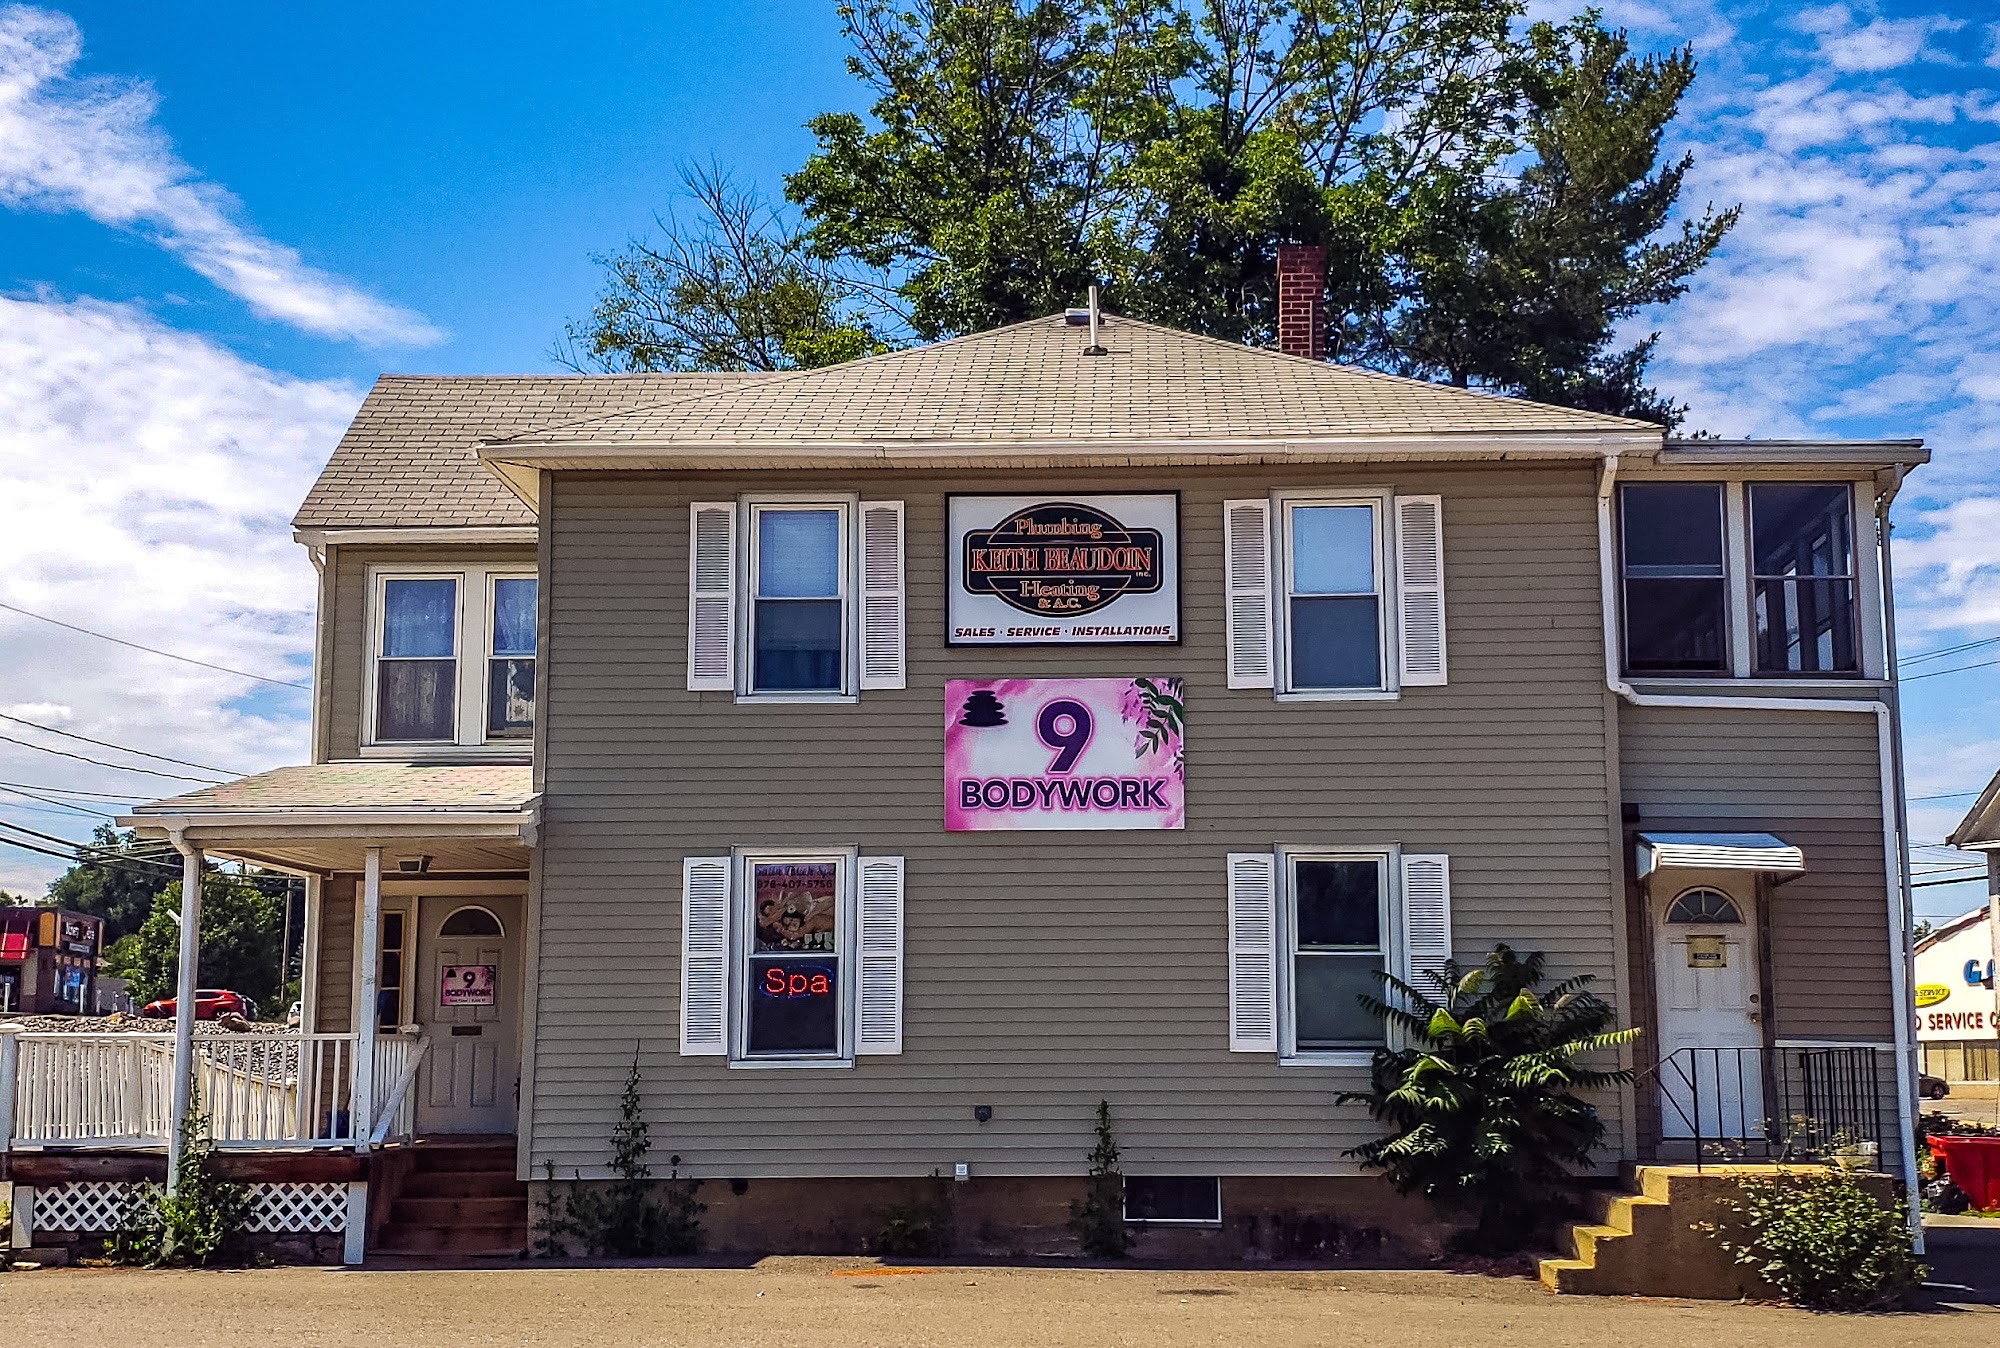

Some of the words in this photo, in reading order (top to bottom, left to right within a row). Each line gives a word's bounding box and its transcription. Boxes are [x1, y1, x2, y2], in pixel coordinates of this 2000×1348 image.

[1014, 517, 1103, 540] Plumbing
[971, 547, 1040, 572] KEITH
[1044, 546, 1153, 572] BEAUDOIN
[1019, 579, 1101, 602] Heating
[1037, 598, 1052, 609] &
[1052, 597, 1082, 609] A.C.
[954, 627, 996, 638] SALES
[1006, 627, 1061, 637] SERVICE
[1071, 625, 1171, 636] INSTALLATIONS
[1038, 700, 1092, 773] 9
[961, 779, 1168, 809] BODYWORK
[463, 971, 475, 988] 9
[766, 967, 829, 997] Spa
[1928, 1012, 1984, 1031] SERVICE
